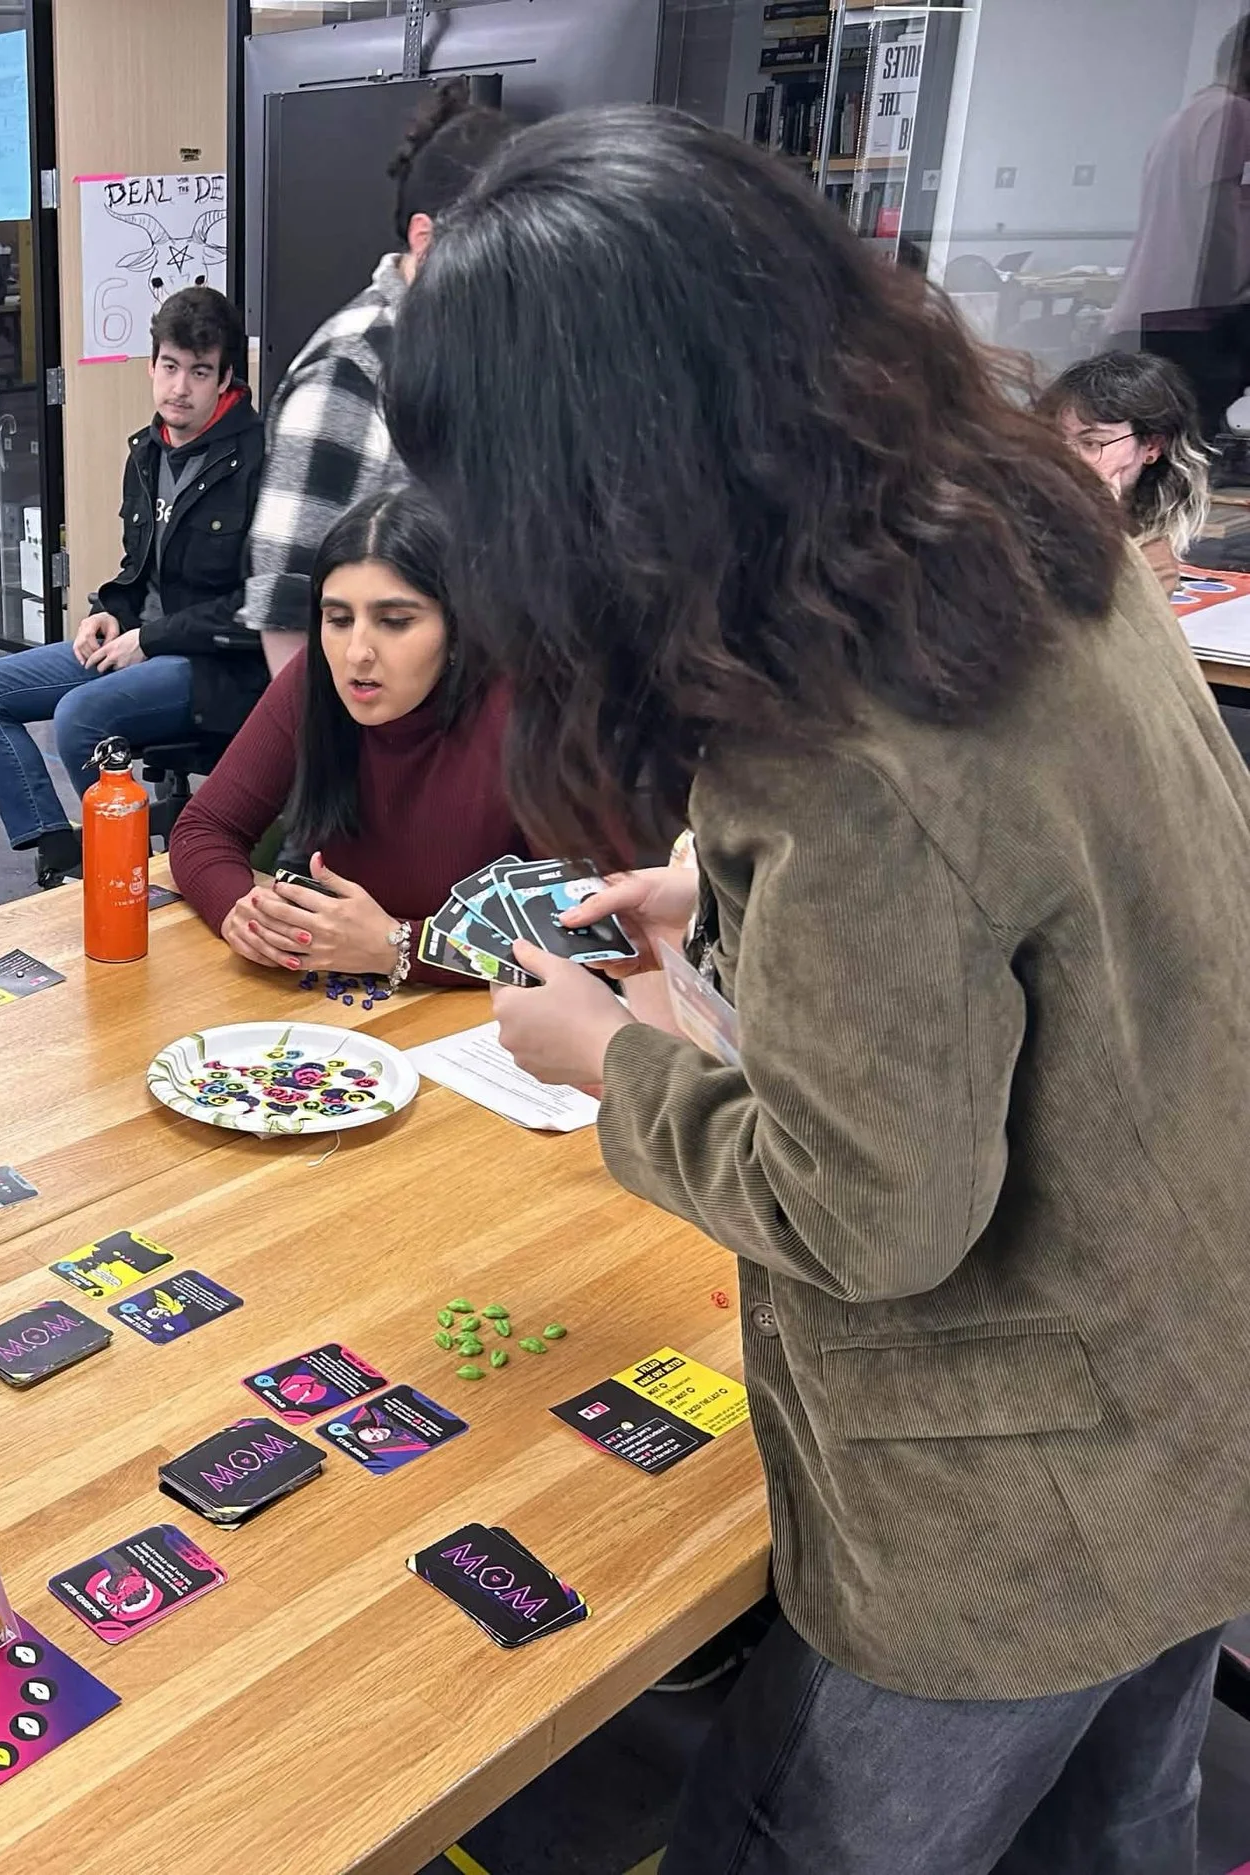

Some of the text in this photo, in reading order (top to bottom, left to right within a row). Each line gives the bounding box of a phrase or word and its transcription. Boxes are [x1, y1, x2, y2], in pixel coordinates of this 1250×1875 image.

[104, 177, 172, 208] DEAL
[94, 278, 133, 348] 6
[58, 1579, 105, 1619] DISCARDED HEART
